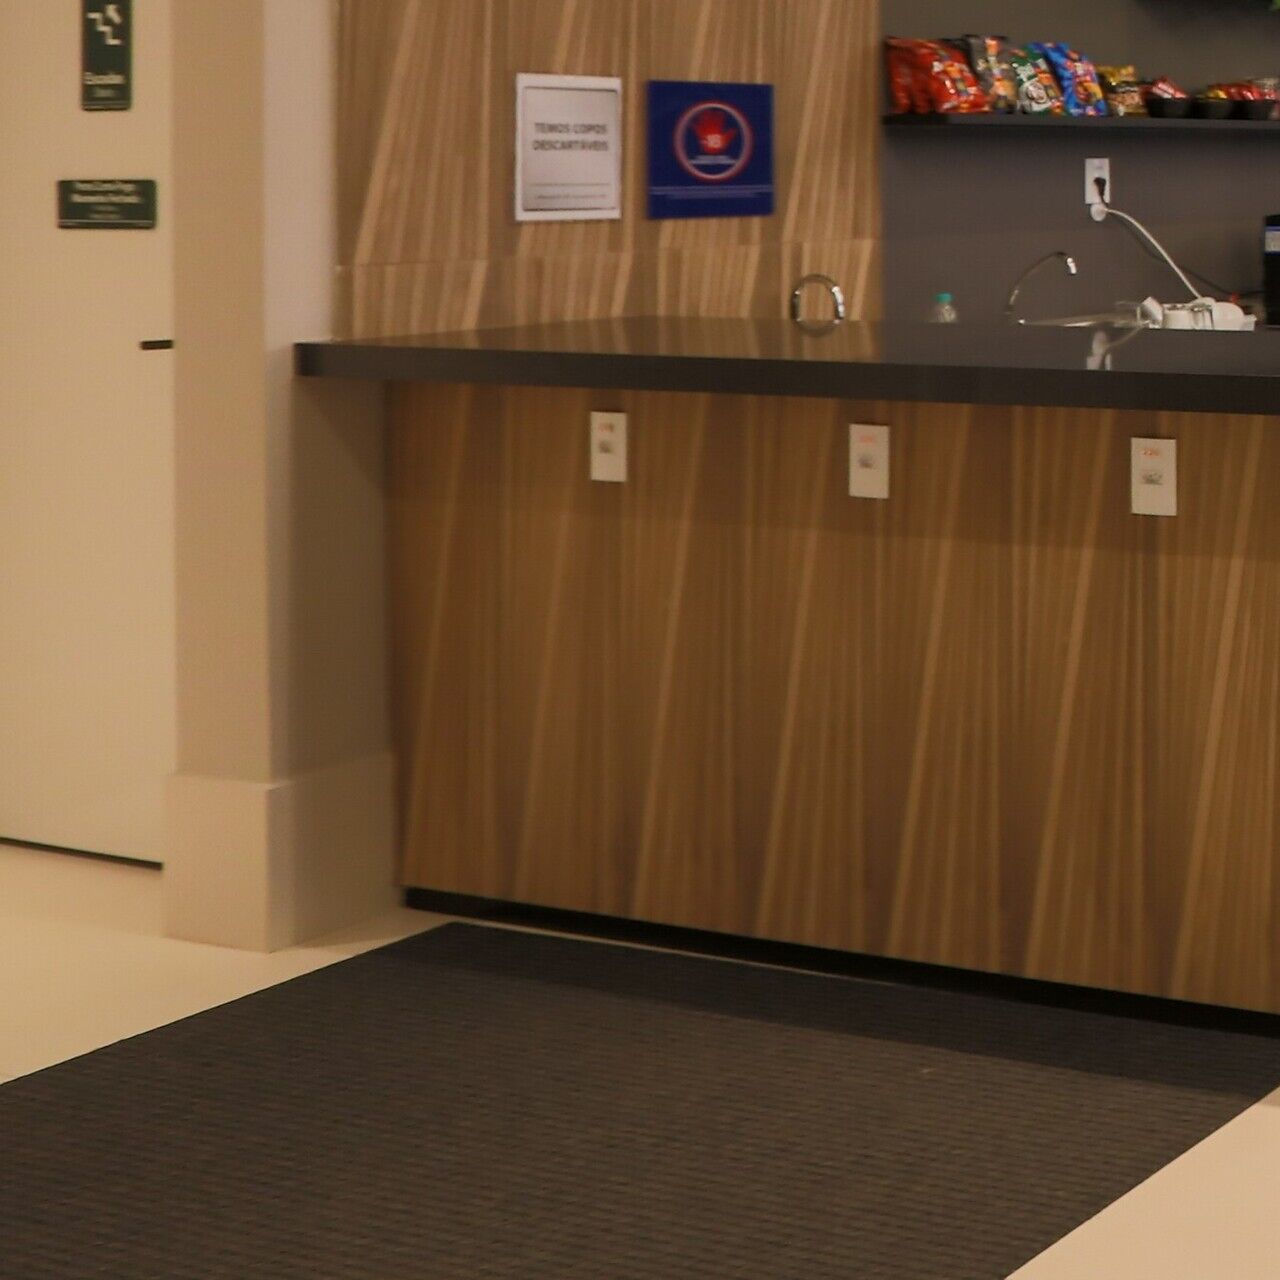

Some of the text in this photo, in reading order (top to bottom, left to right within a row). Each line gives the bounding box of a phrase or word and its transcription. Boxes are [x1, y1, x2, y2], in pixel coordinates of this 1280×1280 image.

[534, 122, 608, 135] TEMOS COPOS
[532, 139, 609, 152] DESCARTÁVEIS
